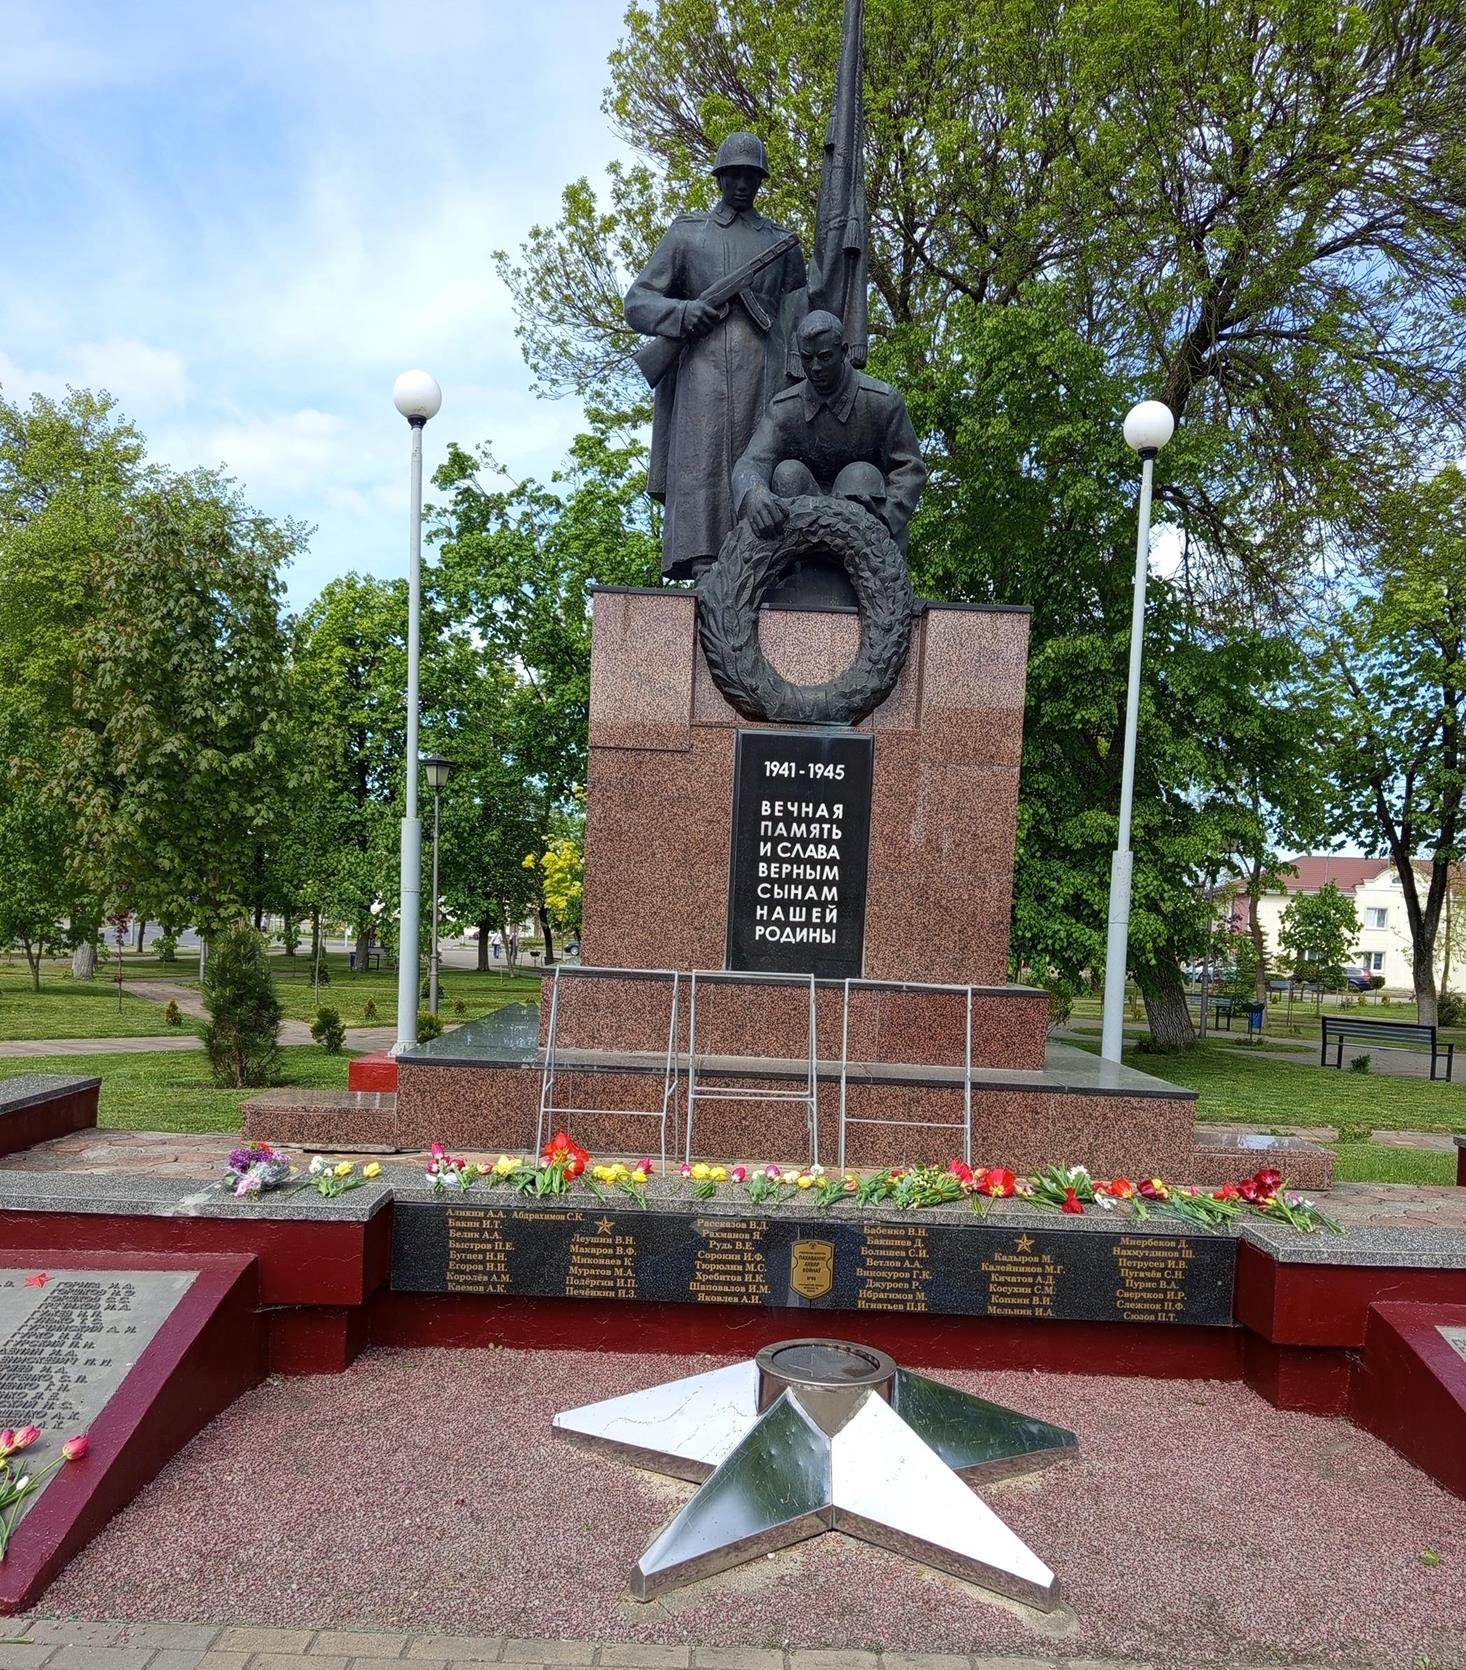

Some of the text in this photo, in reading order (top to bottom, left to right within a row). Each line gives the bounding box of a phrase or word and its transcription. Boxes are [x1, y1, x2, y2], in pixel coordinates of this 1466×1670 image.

[761, 801, 843, 819] ВЕЧНАЯ
[760, 821, 842, 840] ПАМЯТЬ
[759, 842, 840, 860] И СЛАВА
[758, 863, 839, 880] ВЕРНЫМ
[757, 883, 838, 901] СЫНАМ
[756, 905, 837, 923] НАШЕЙ
[755, 926, 836, 944] РОДИНЫ
[449, 1261, 483, 1271] Егоров
[568, 1266, 611, 1277] Муратов
